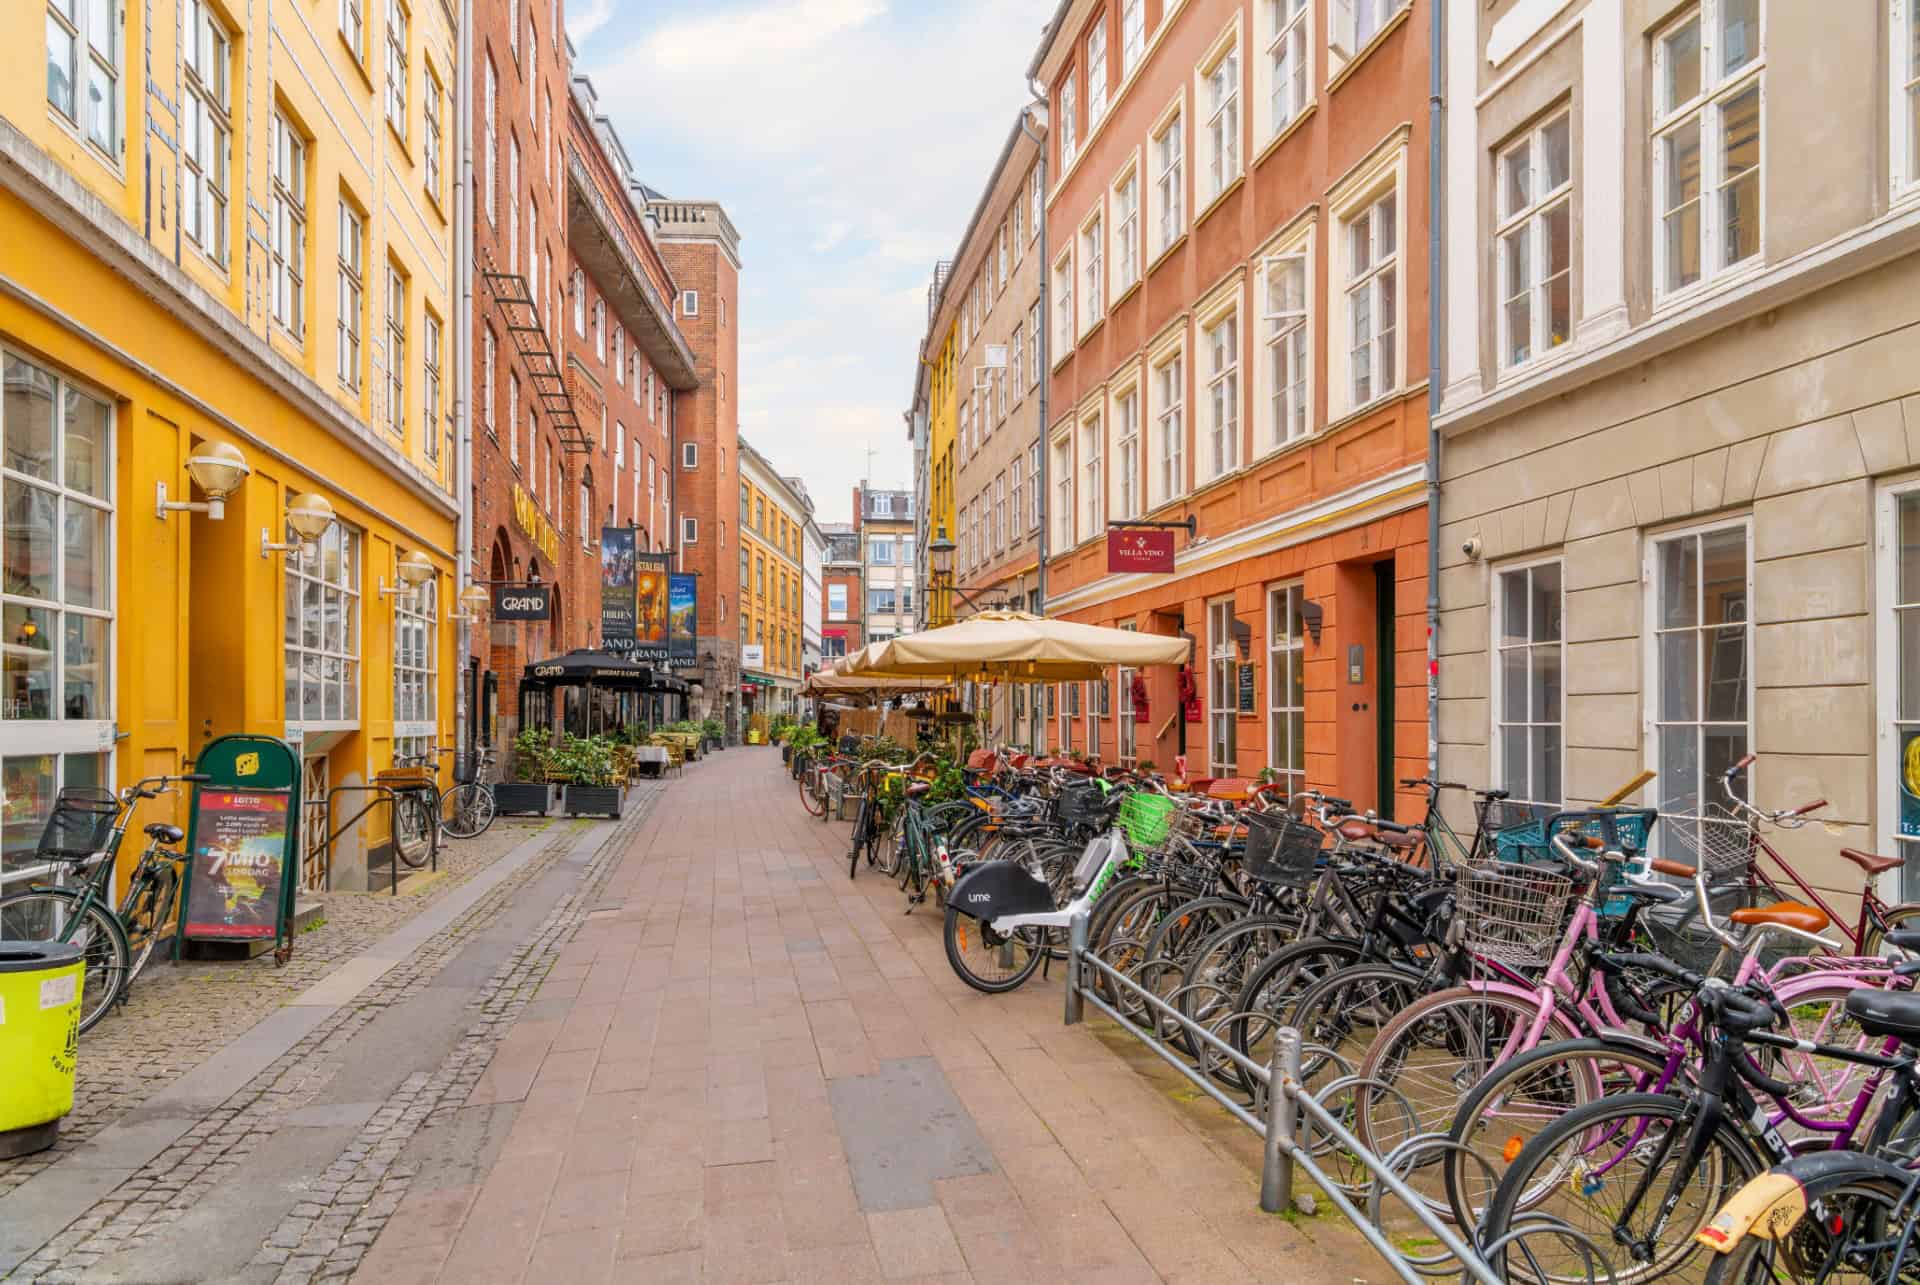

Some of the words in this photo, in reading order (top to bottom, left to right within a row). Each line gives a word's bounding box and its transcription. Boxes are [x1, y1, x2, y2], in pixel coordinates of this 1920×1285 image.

[1143, 549, 1165, 557] VINO
[502, 597, 544, 611] GRAND
[535, 665, 565, 677] GRAND
[233, 796, 260, 804] LOTTO
[207, 847, 227, 875] 7
